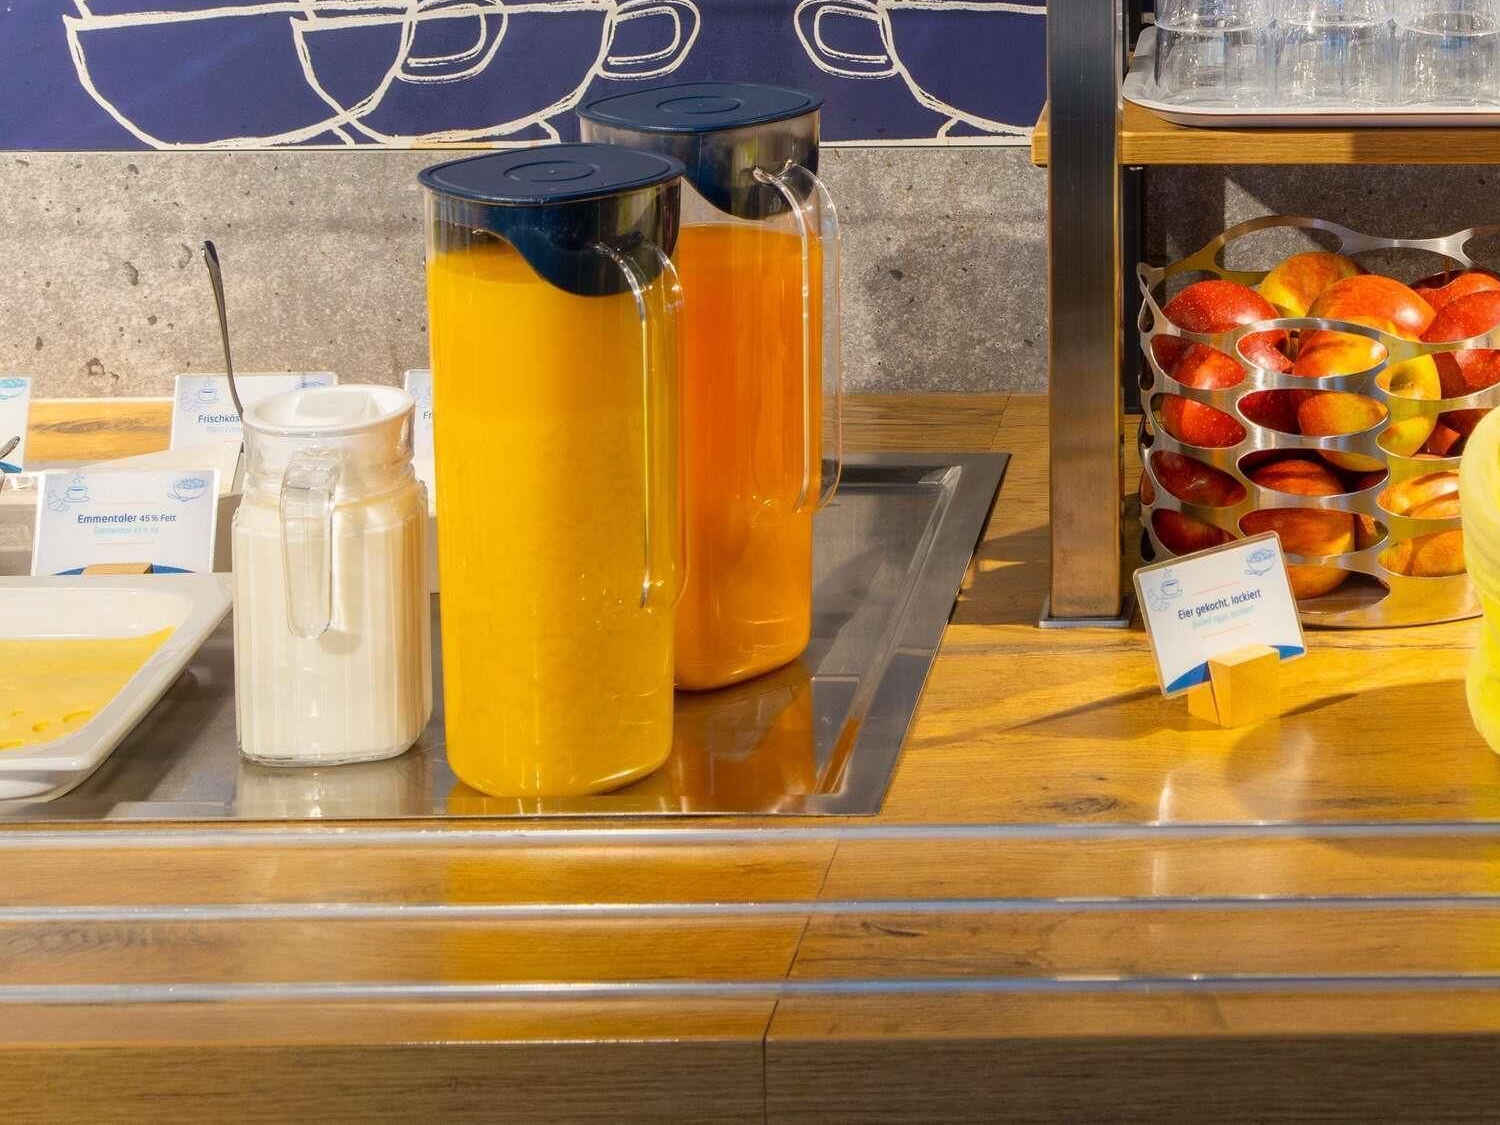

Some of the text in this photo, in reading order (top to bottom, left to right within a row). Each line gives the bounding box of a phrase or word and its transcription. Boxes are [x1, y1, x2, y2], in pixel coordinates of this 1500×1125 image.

[198, 413, 241, 423] Frischkäs
[77, 514, 137, 523] Emmentaler
[160, 514, 177, 522] Fett
[1177, 609, 1194, 620] Eier
[1231, 589, 1261, 605] lackiert
